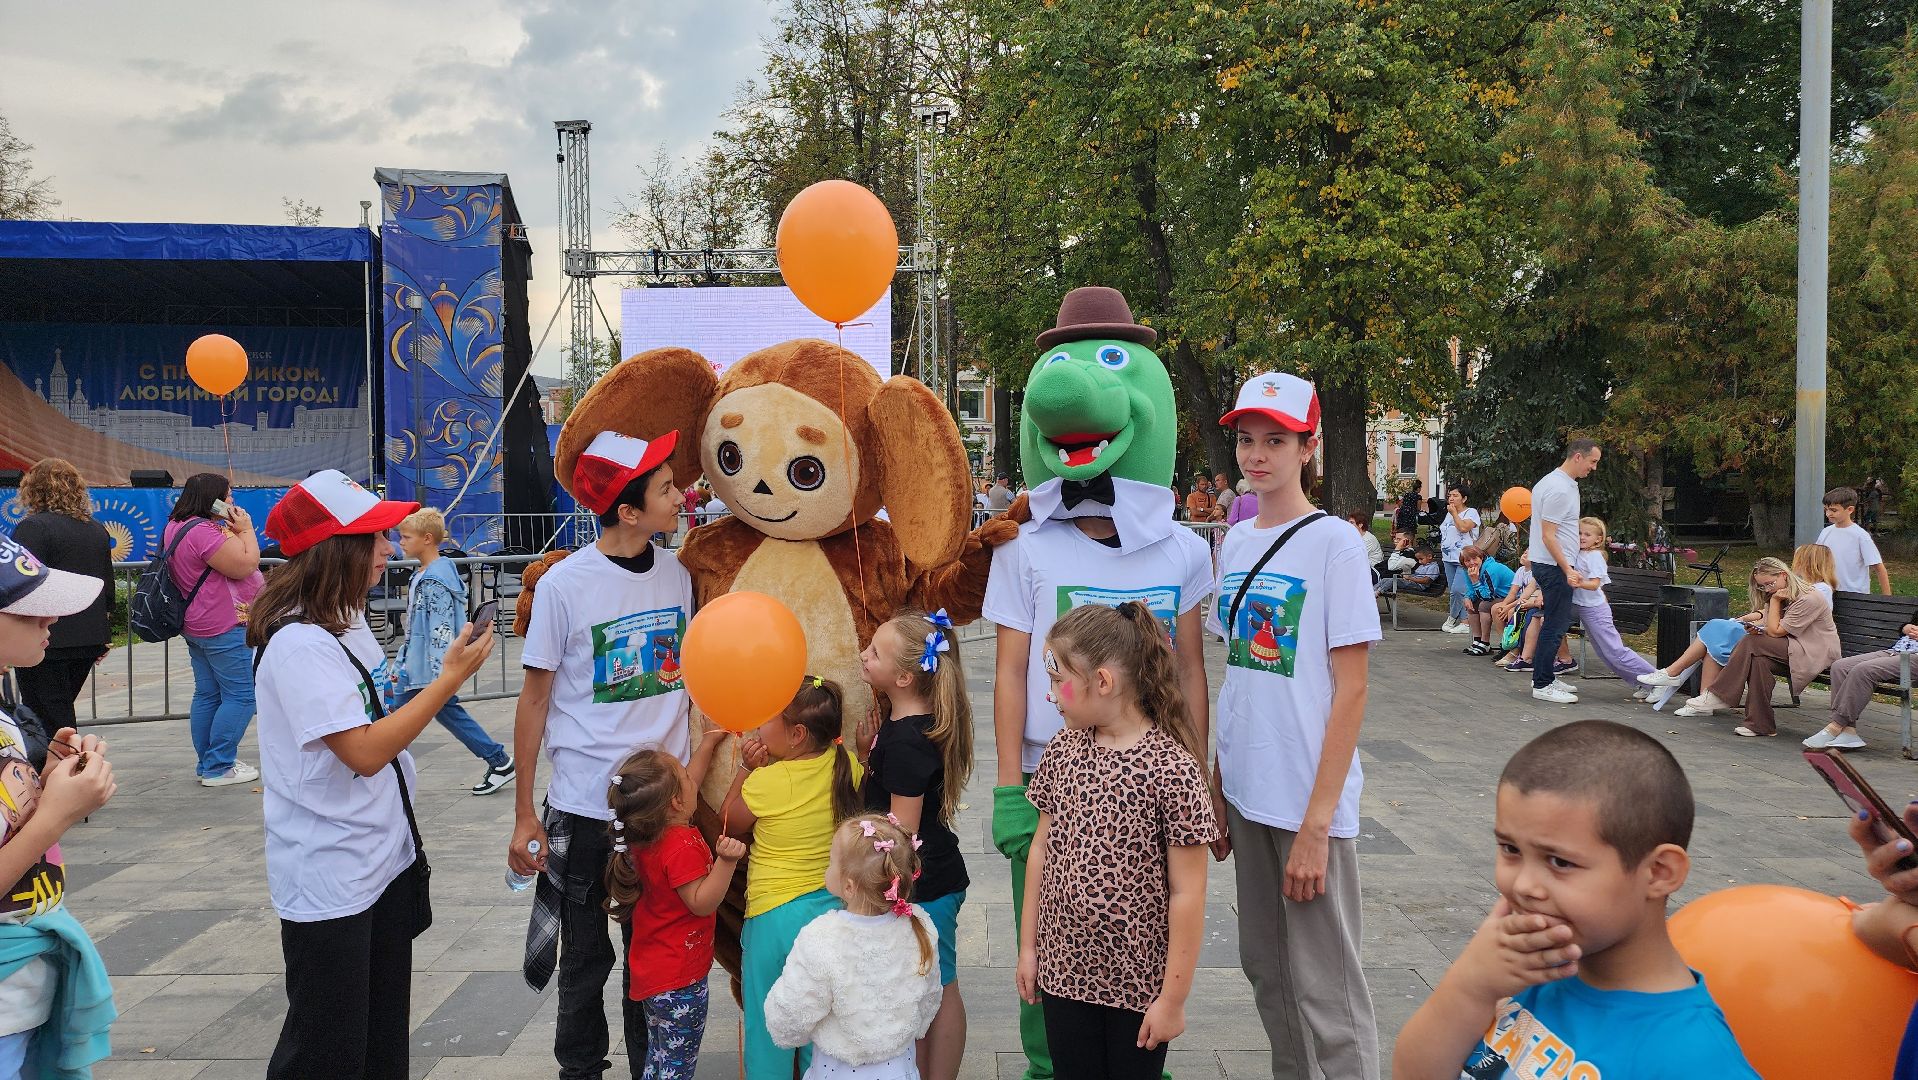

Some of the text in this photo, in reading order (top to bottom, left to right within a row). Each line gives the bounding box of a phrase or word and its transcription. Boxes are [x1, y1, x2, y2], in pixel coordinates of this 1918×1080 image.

[139, 364, 156, 379] С
[120, 384, 339, 403] ЛЮБИМЙ ГОРОД!
